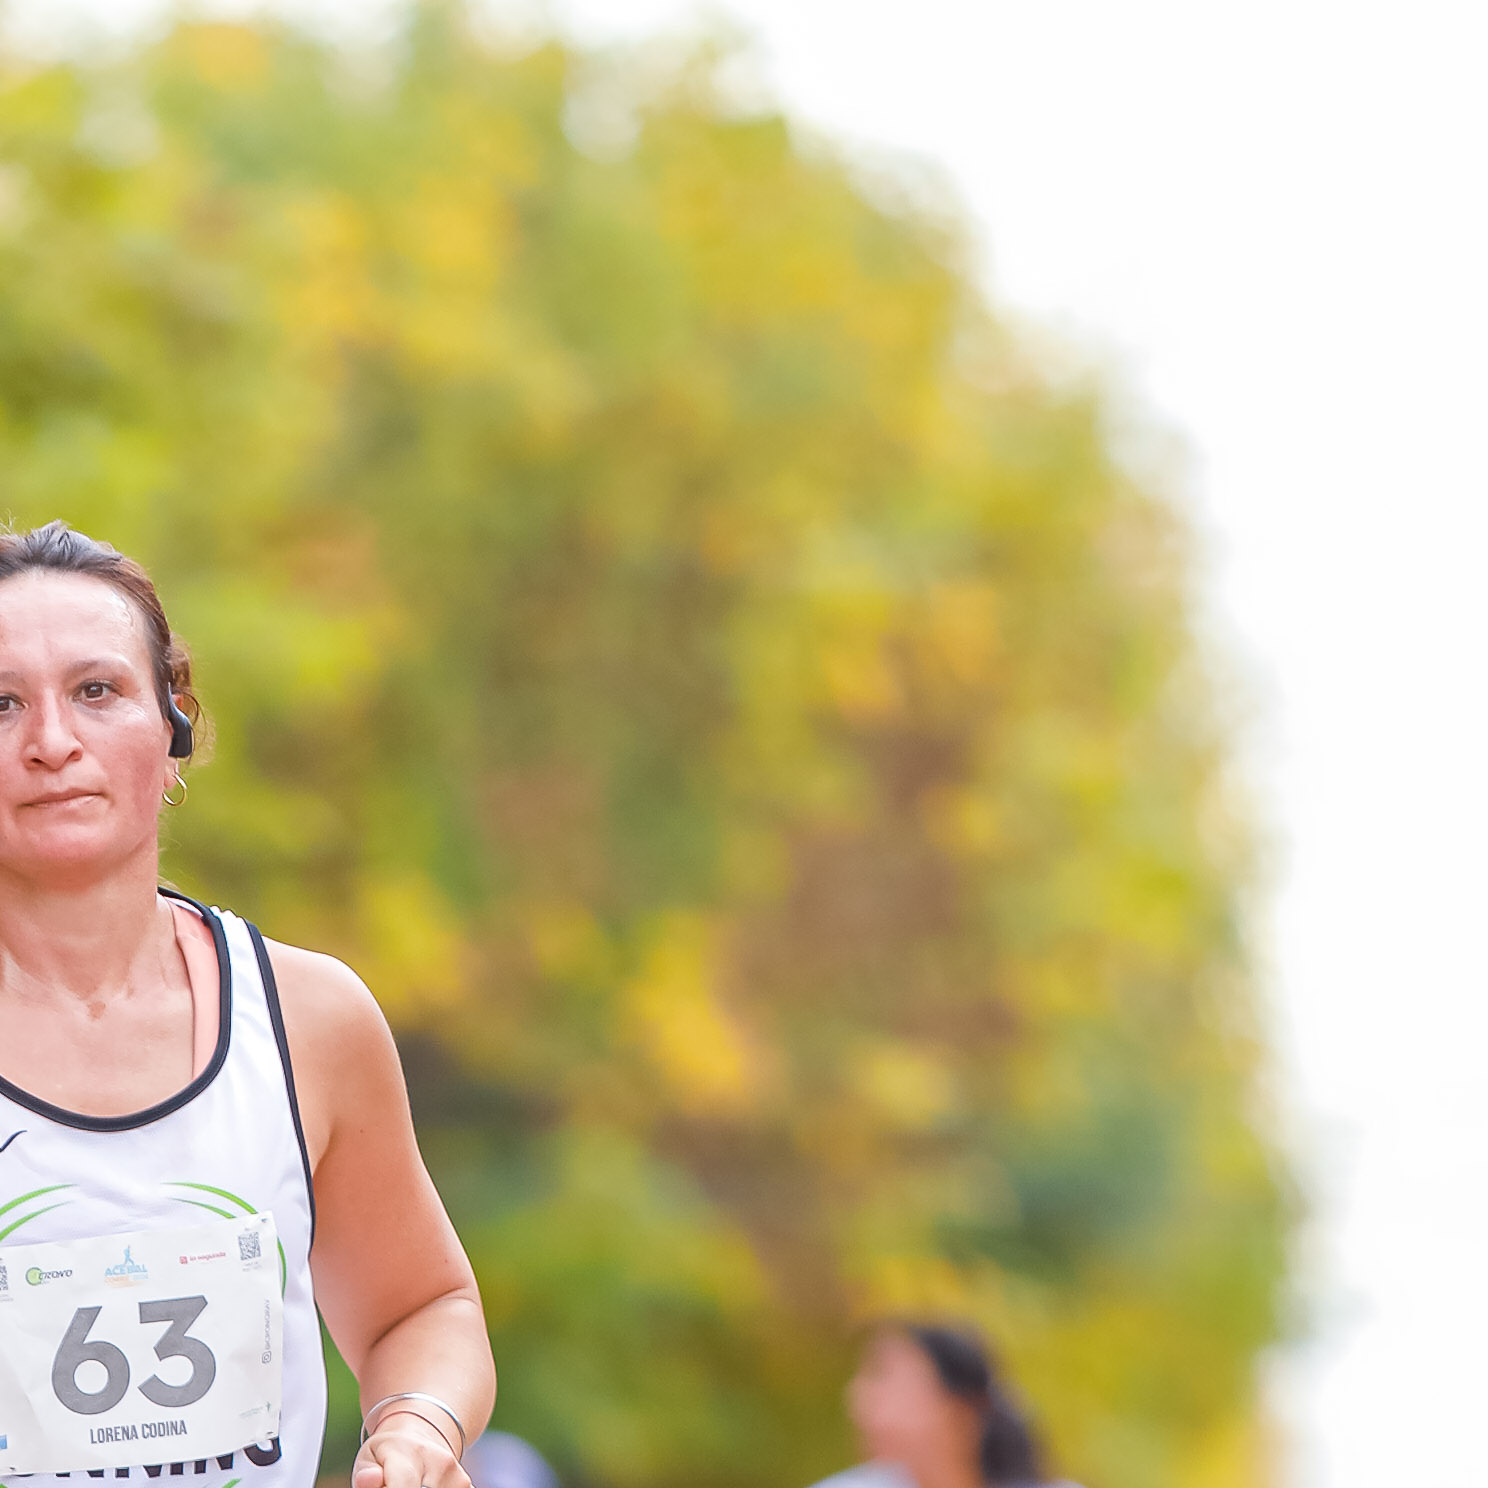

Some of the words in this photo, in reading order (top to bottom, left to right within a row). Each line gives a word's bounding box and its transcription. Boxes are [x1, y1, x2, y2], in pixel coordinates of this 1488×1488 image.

[51, 1295, 217, 1415] 63
[90, 1424, 139, 1445] LORENA
[141, 1419, 188, 1439] CODINA
